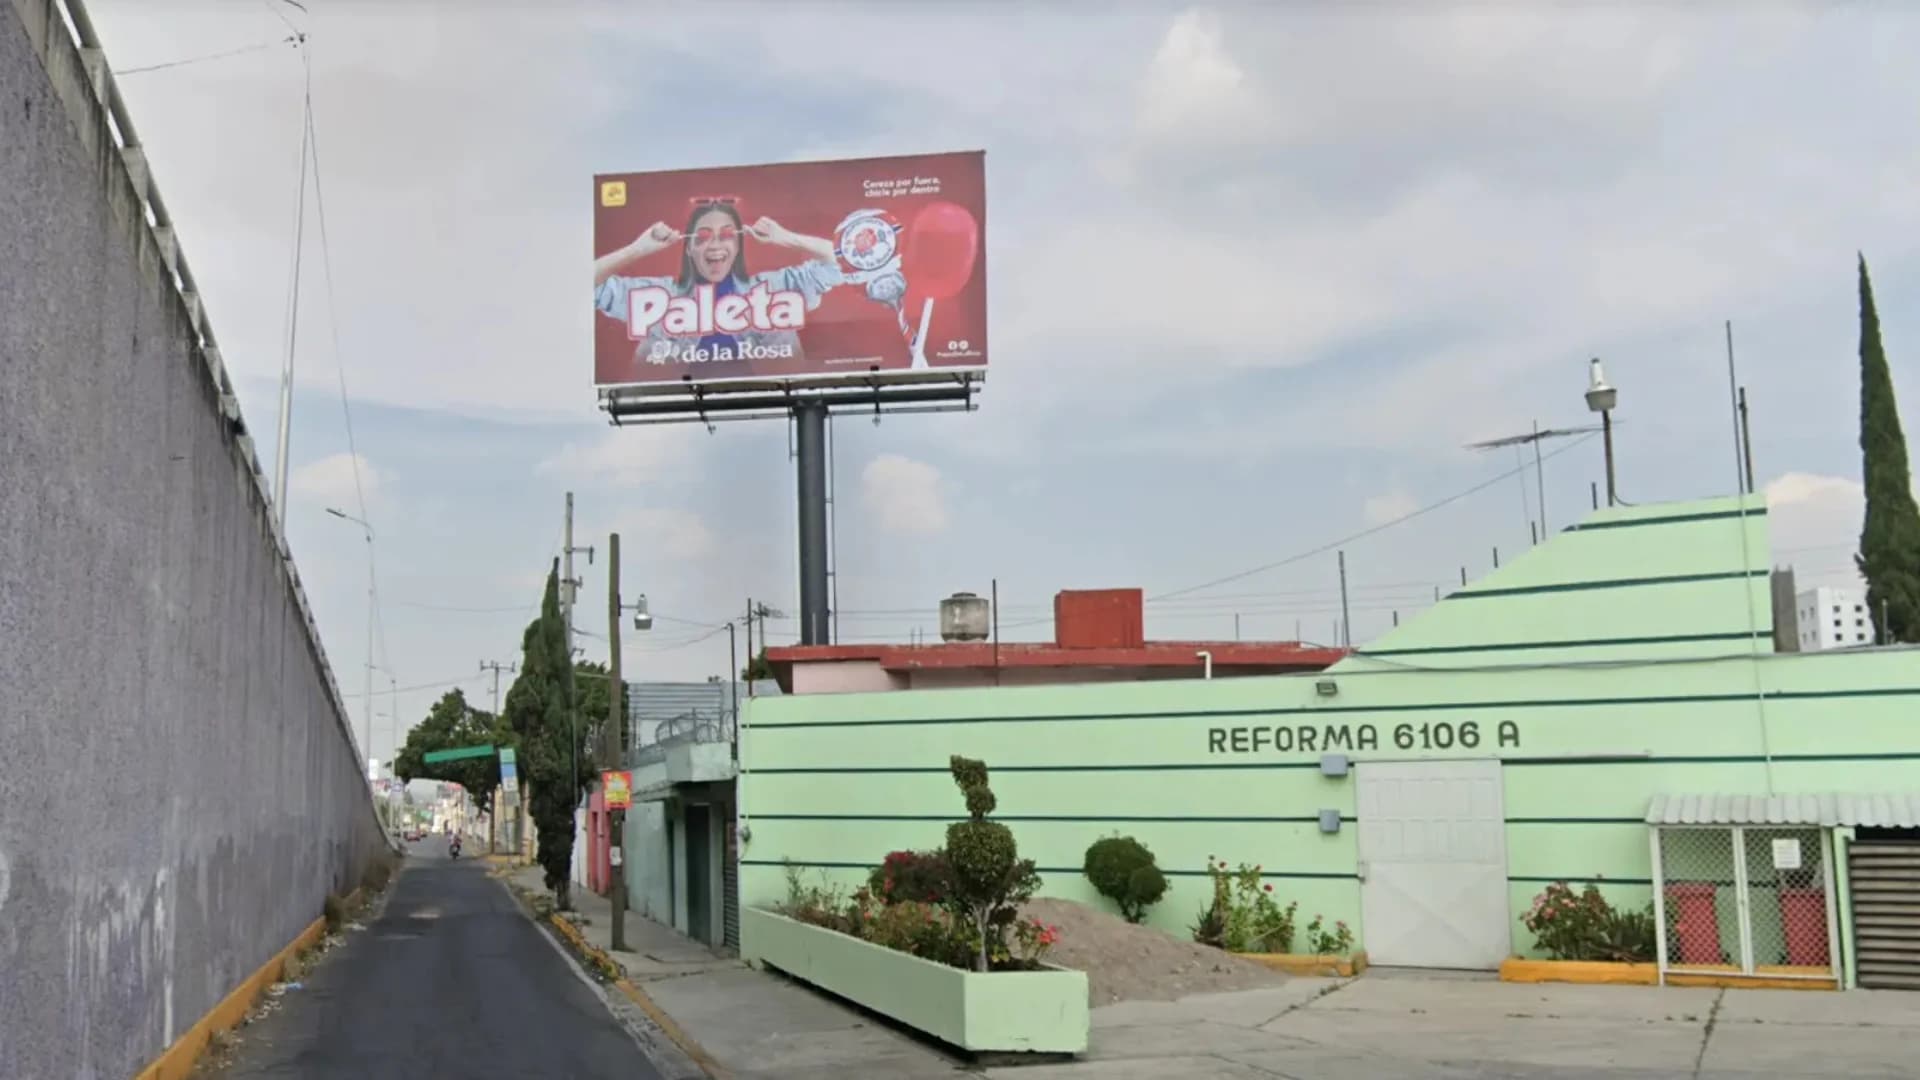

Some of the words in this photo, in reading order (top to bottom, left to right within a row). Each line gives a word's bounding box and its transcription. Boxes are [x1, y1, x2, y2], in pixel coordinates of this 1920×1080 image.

[629, 281, 806, 340] Paleta
[682, 344, 707, 363] de
[712, 343, 733, 362] la
[738, 340, 793, 359] Rosa
[1208, 725, 1378, 752] REFORMA
[1393, 722, 1480, 749] 6106
[1498, 720, 1520, 748] A
